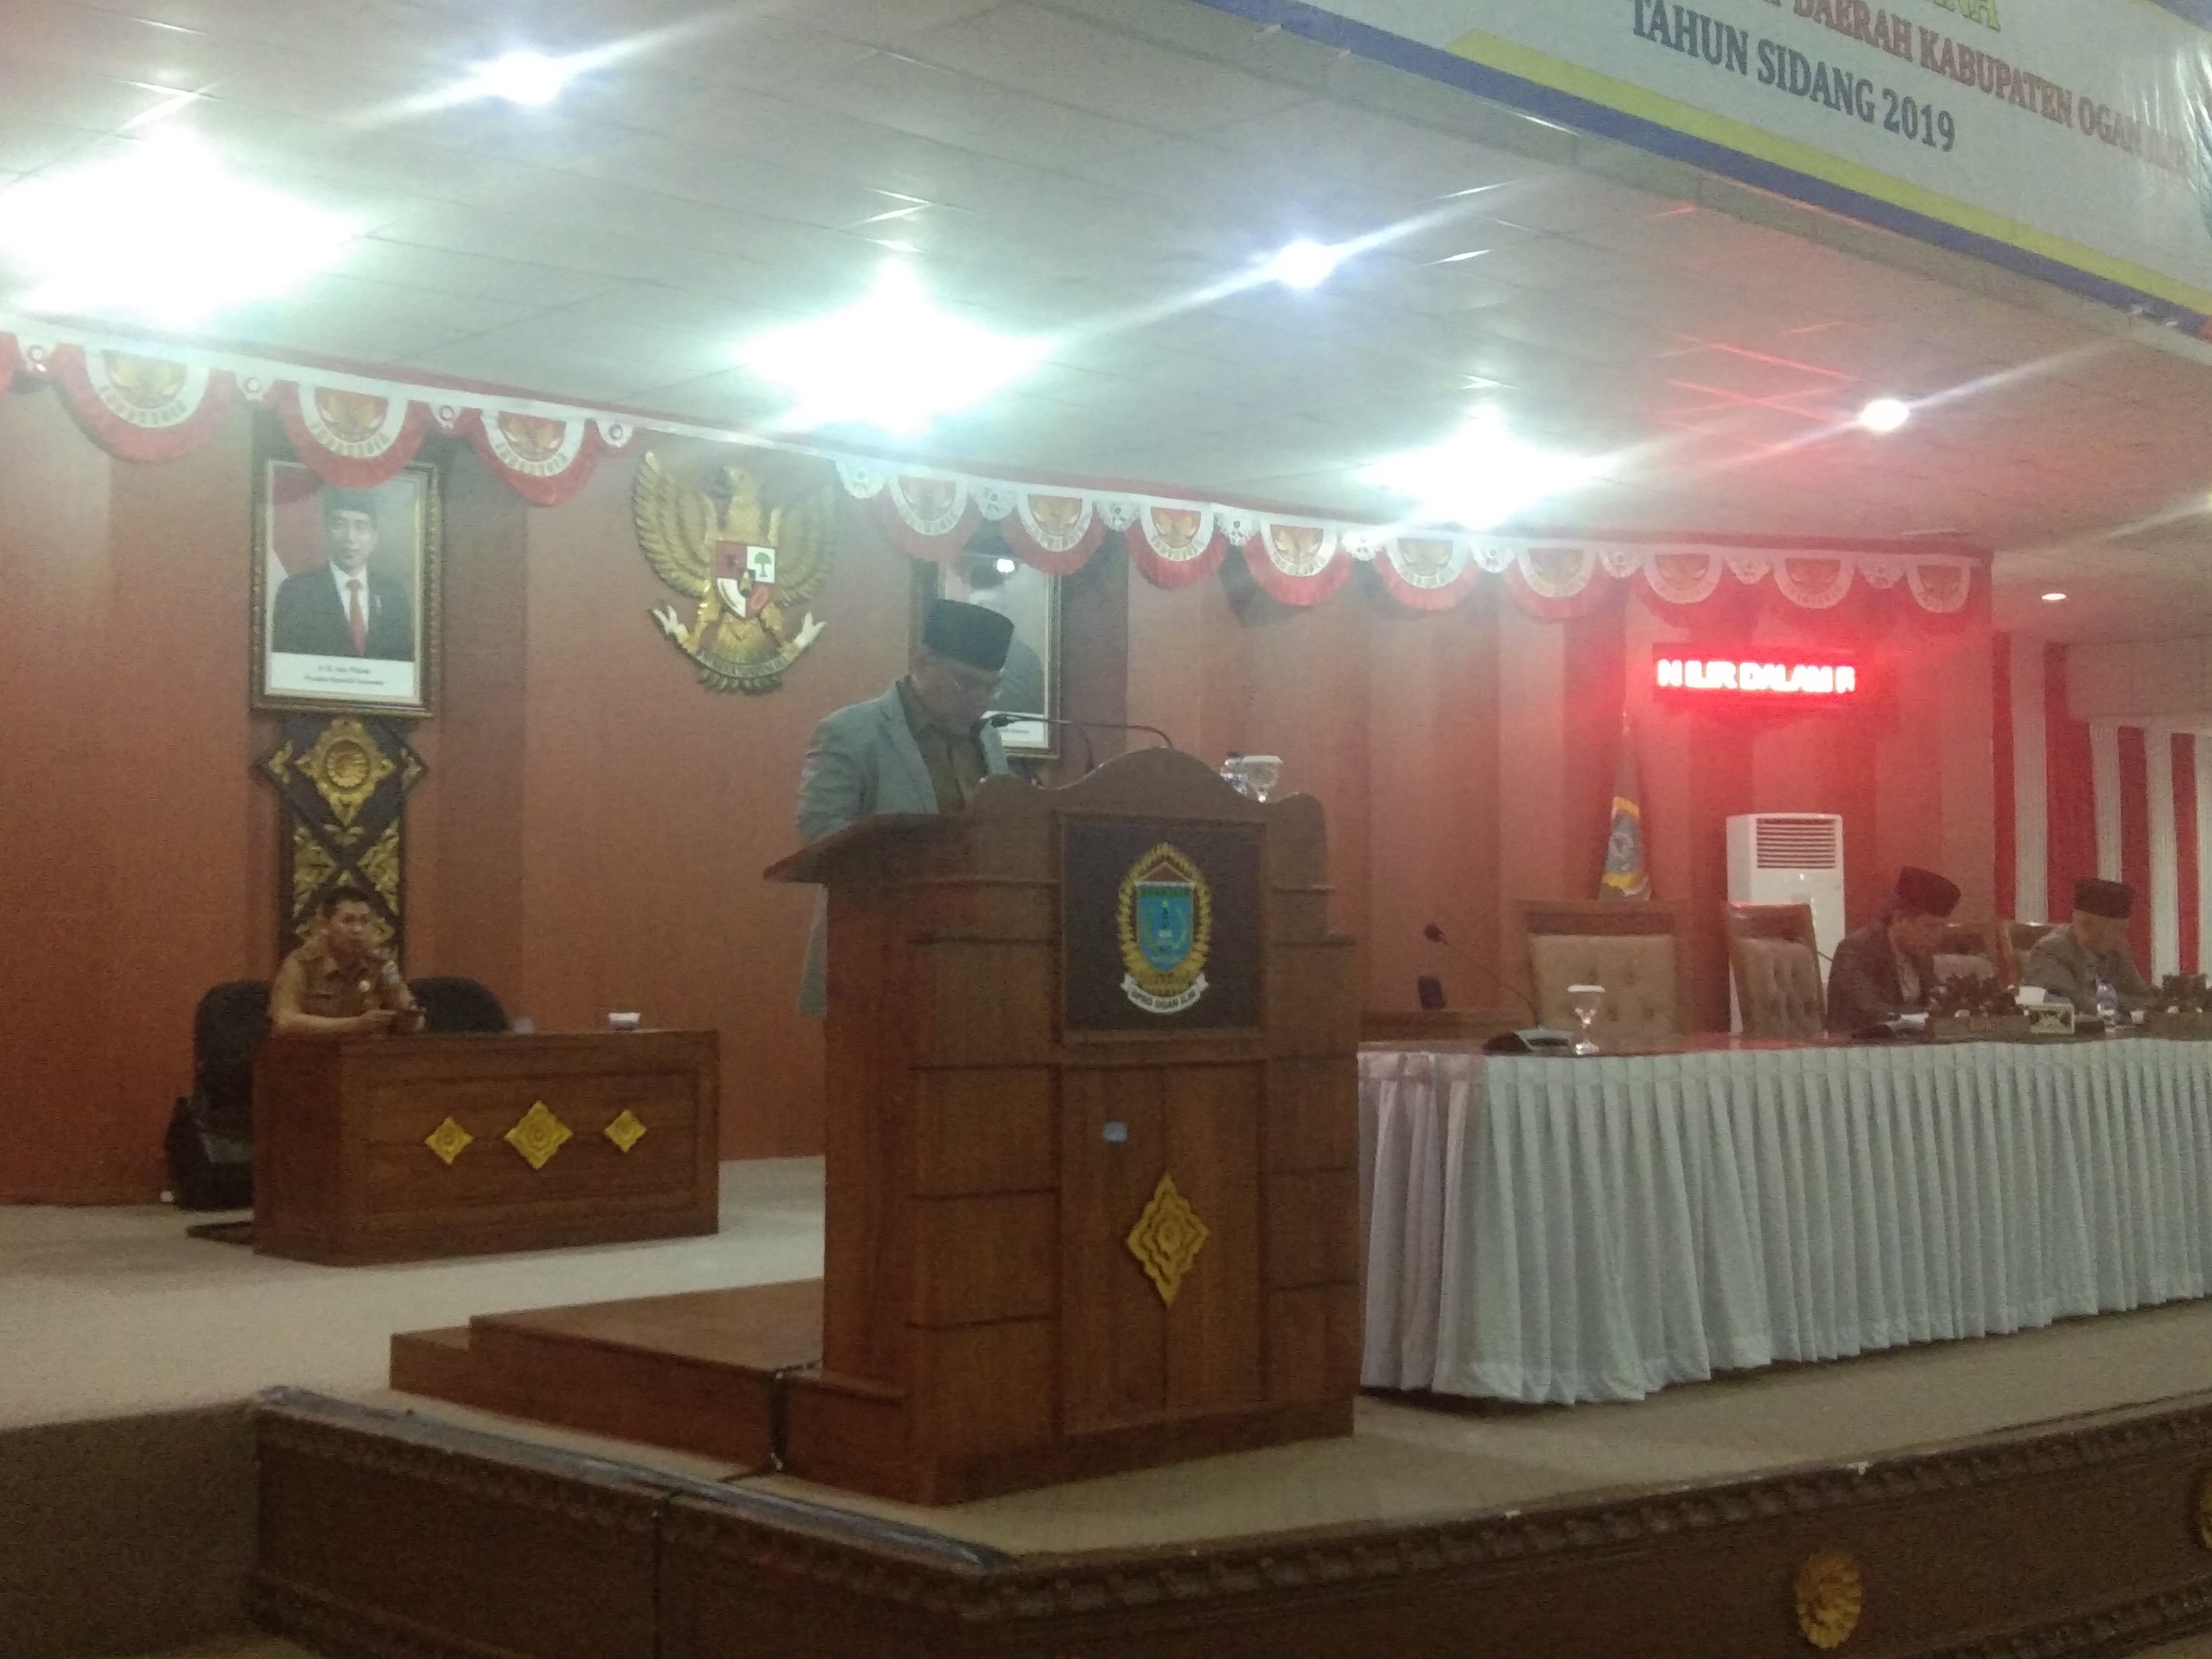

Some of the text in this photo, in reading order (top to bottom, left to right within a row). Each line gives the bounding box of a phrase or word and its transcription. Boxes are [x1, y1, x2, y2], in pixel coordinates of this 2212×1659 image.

[1633, 0, 1955, 152] TAHUN SIDANG 2019
[1918, 26, 2073, 128] KABUPATEN
